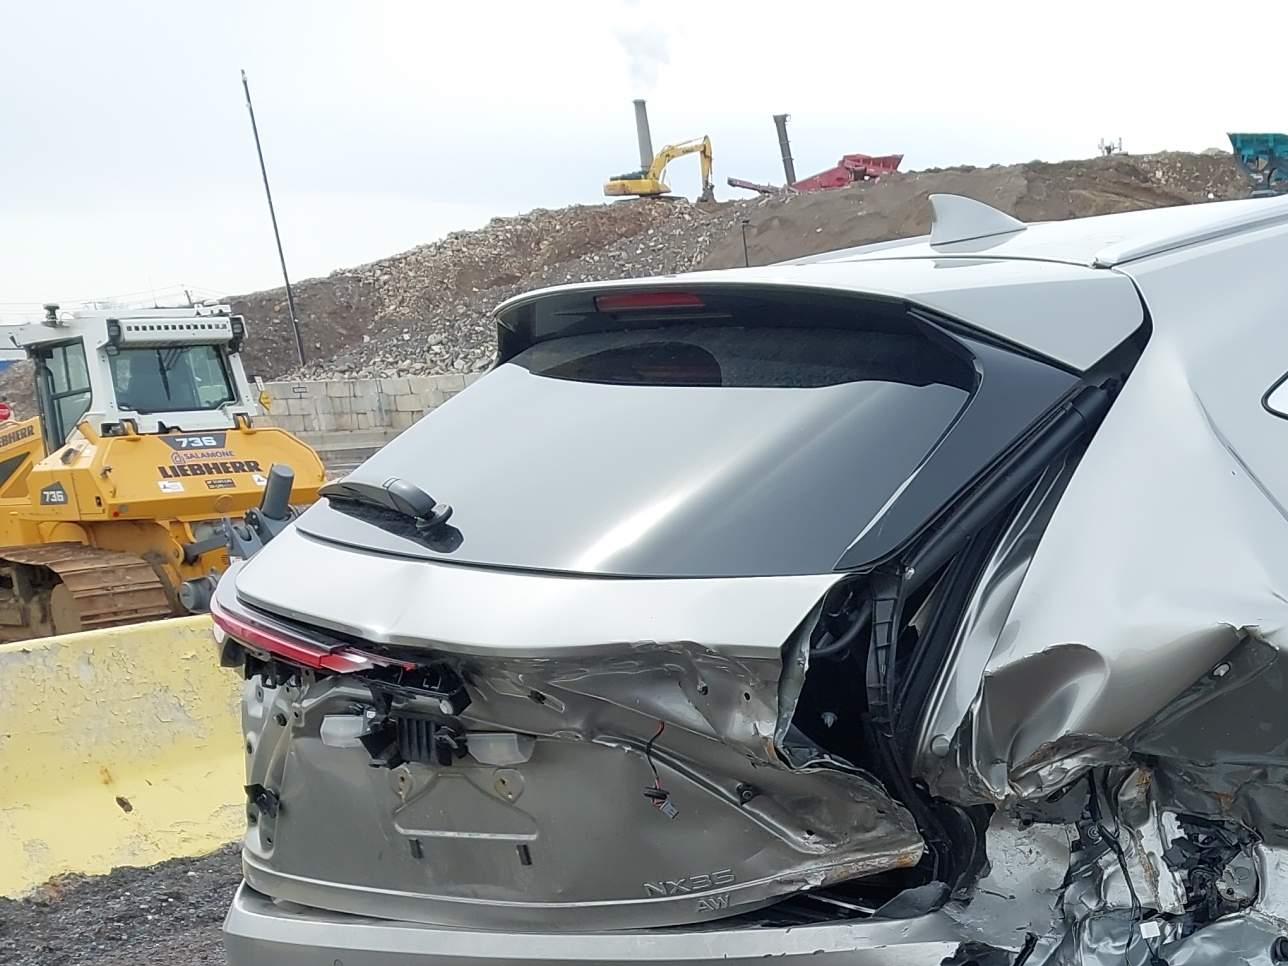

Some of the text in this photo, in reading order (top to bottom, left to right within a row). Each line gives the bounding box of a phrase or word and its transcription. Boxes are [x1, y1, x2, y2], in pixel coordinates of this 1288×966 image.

[174, 436, 217, 448] 736
[158, 460, 263, 479] LIEBHERR
[43, 490, 64, 502] 736
